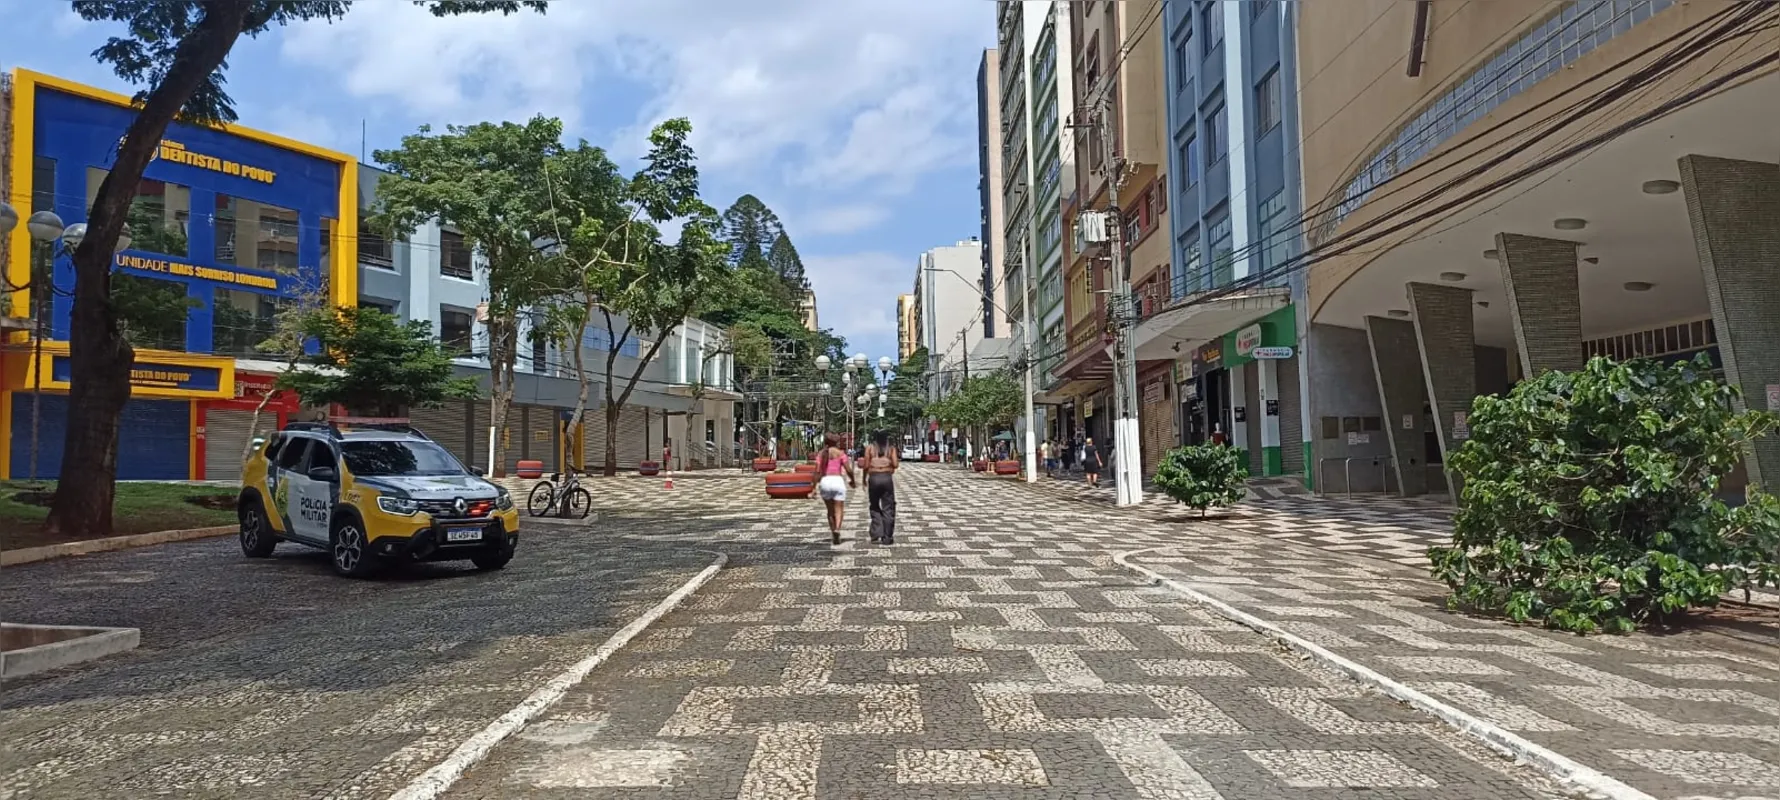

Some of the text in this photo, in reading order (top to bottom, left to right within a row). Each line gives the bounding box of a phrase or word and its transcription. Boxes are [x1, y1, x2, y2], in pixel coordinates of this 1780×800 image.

[160, 146, 274, 184] DENTISTA DO POVO
[116, 254, 168, 273] UNIDADE
[169, 262, 195, 276] MAIS
[195, 267, 235, 283] SORRISO
[131, 369, 153, 379] TISTA
[300, 509, 327, 521] MILITAR
